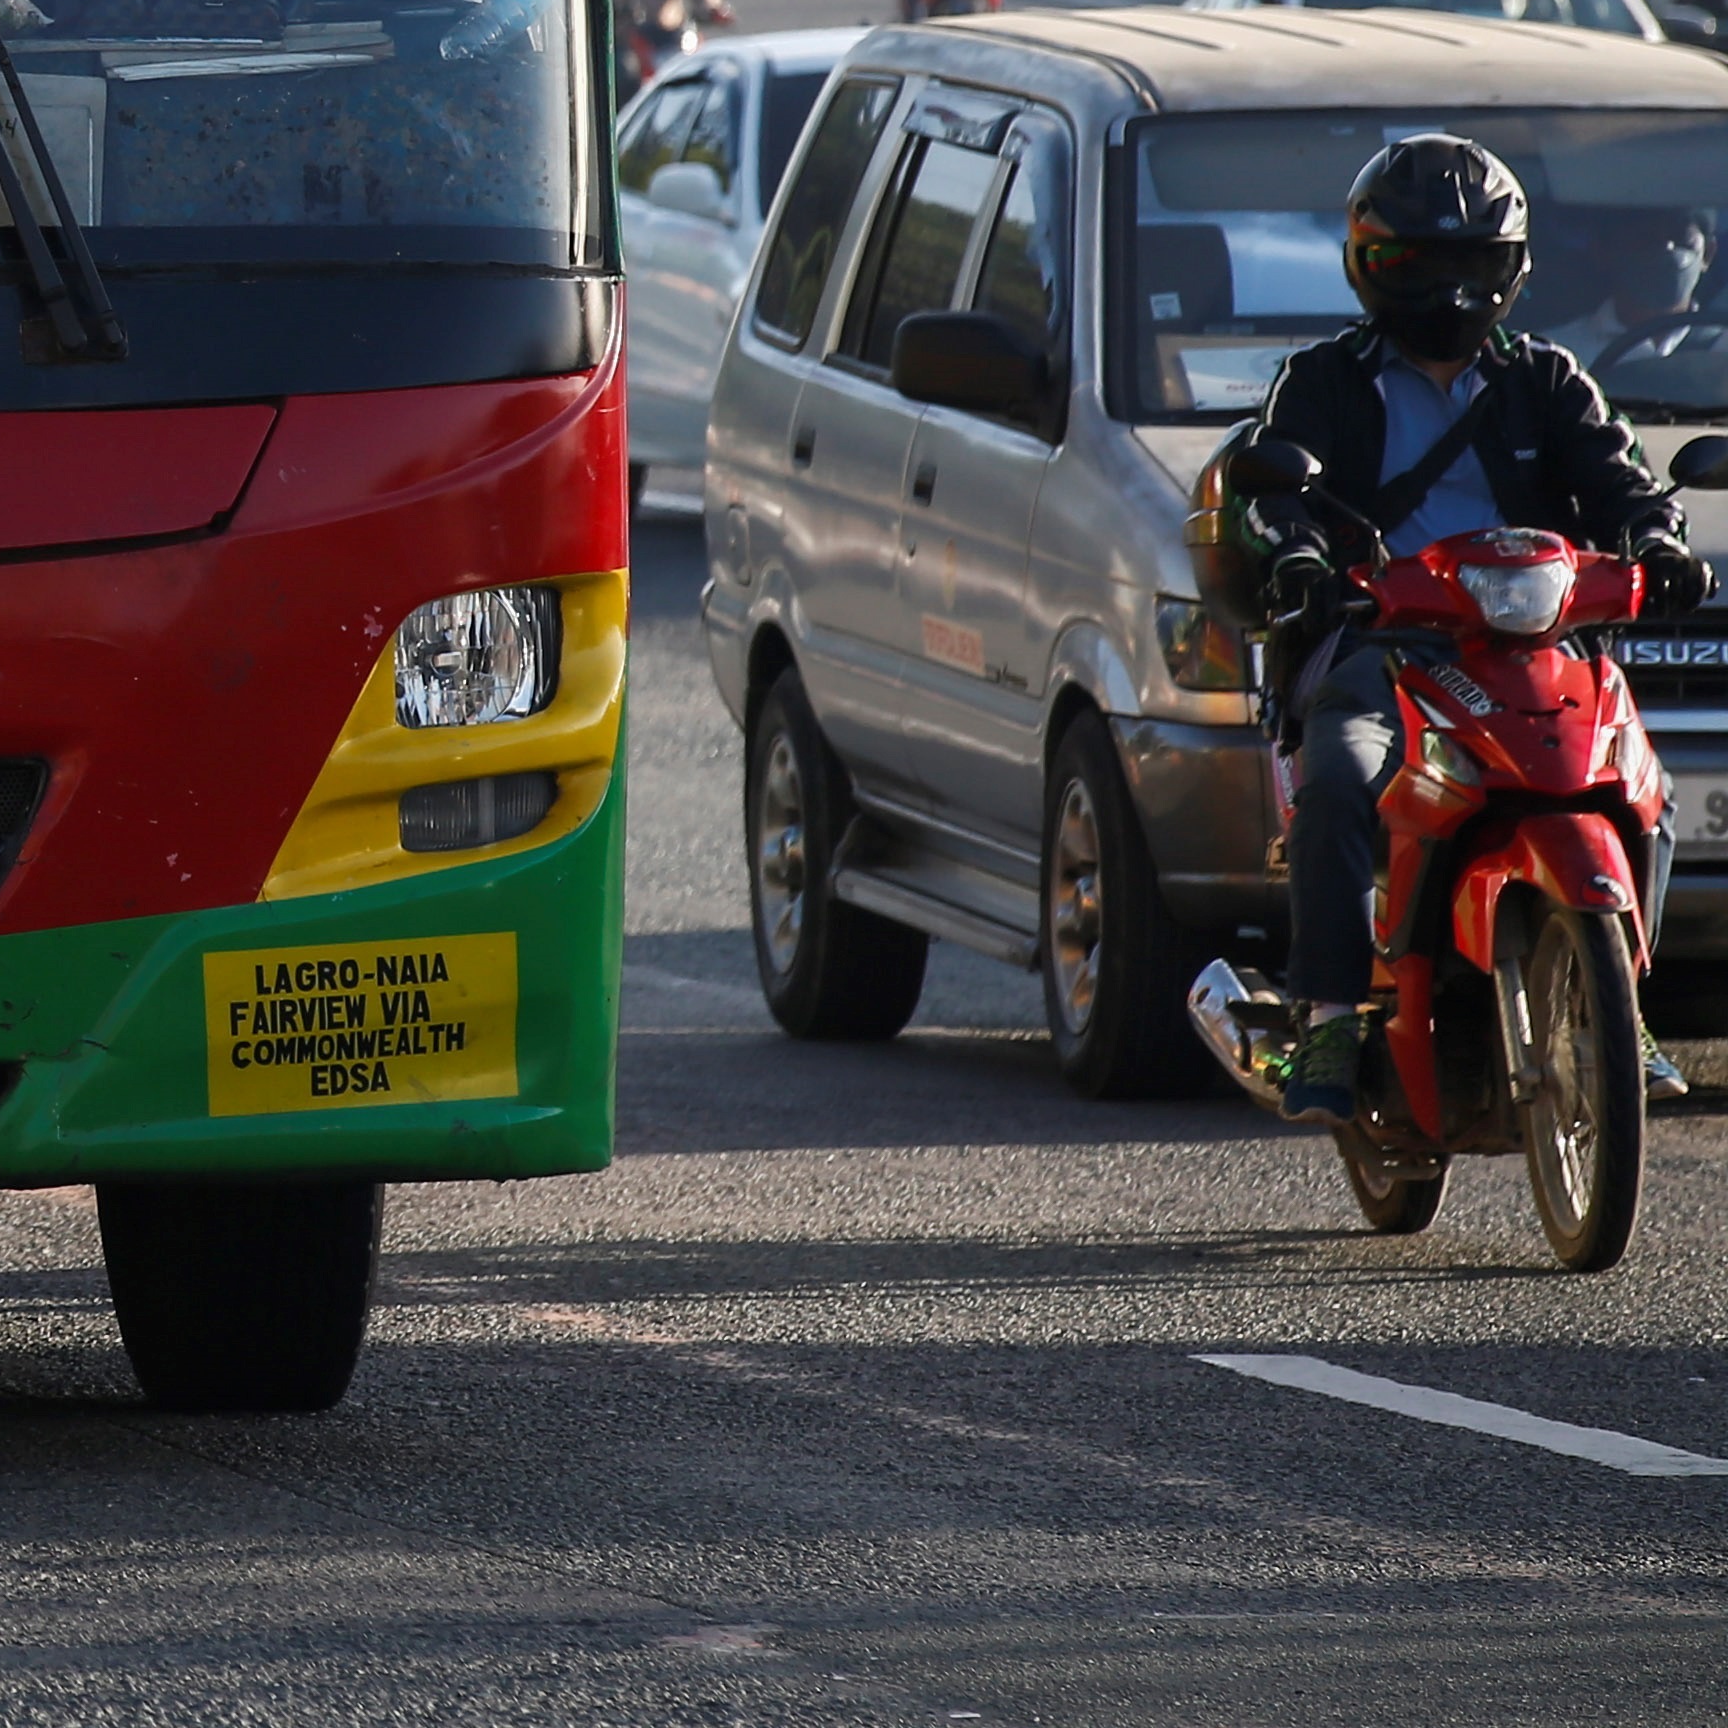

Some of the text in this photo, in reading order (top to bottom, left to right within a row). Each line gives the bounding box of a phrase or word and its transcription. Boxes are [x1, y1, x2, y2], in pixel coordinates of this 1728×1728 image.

[1623, 640, 1728, 665] ISUZ
[255, 952, 449, 996] LAGRO-NAIA
[229, 990, 431, 1036] FAIRVIEW VIA
[231, 1022, 466, 1069] COMMONWEALTH
[310, 1061, 391, 1097] EDSA
